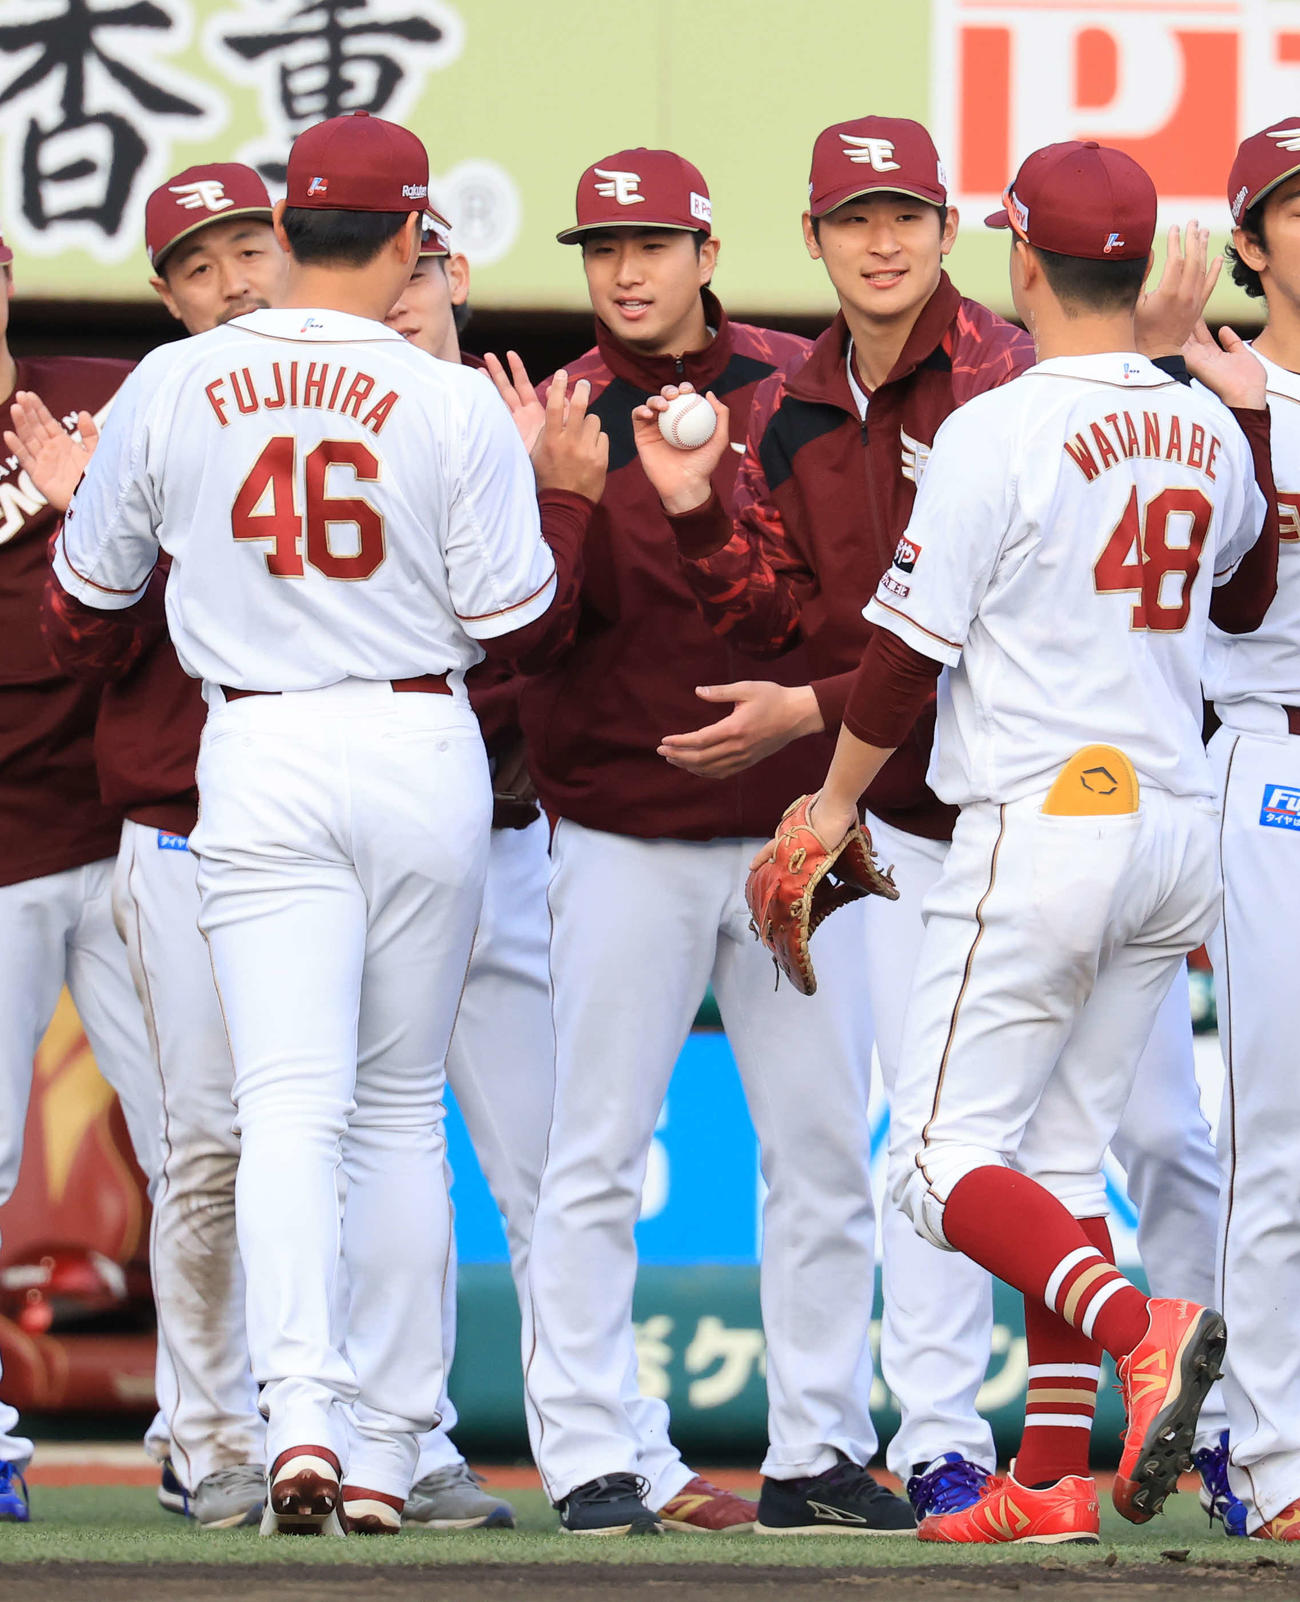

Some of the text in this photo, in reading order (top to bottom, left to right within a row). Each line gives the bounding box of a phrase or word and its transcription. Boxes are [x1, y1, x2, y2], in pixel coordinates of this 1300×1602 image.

[204, 361, 400, 437] FUJIHIRA
[1063, 410, 1222, 484] WATANABE
[231, 433, 387, 582] 46
[1093, 484, 1215, 633] 48
